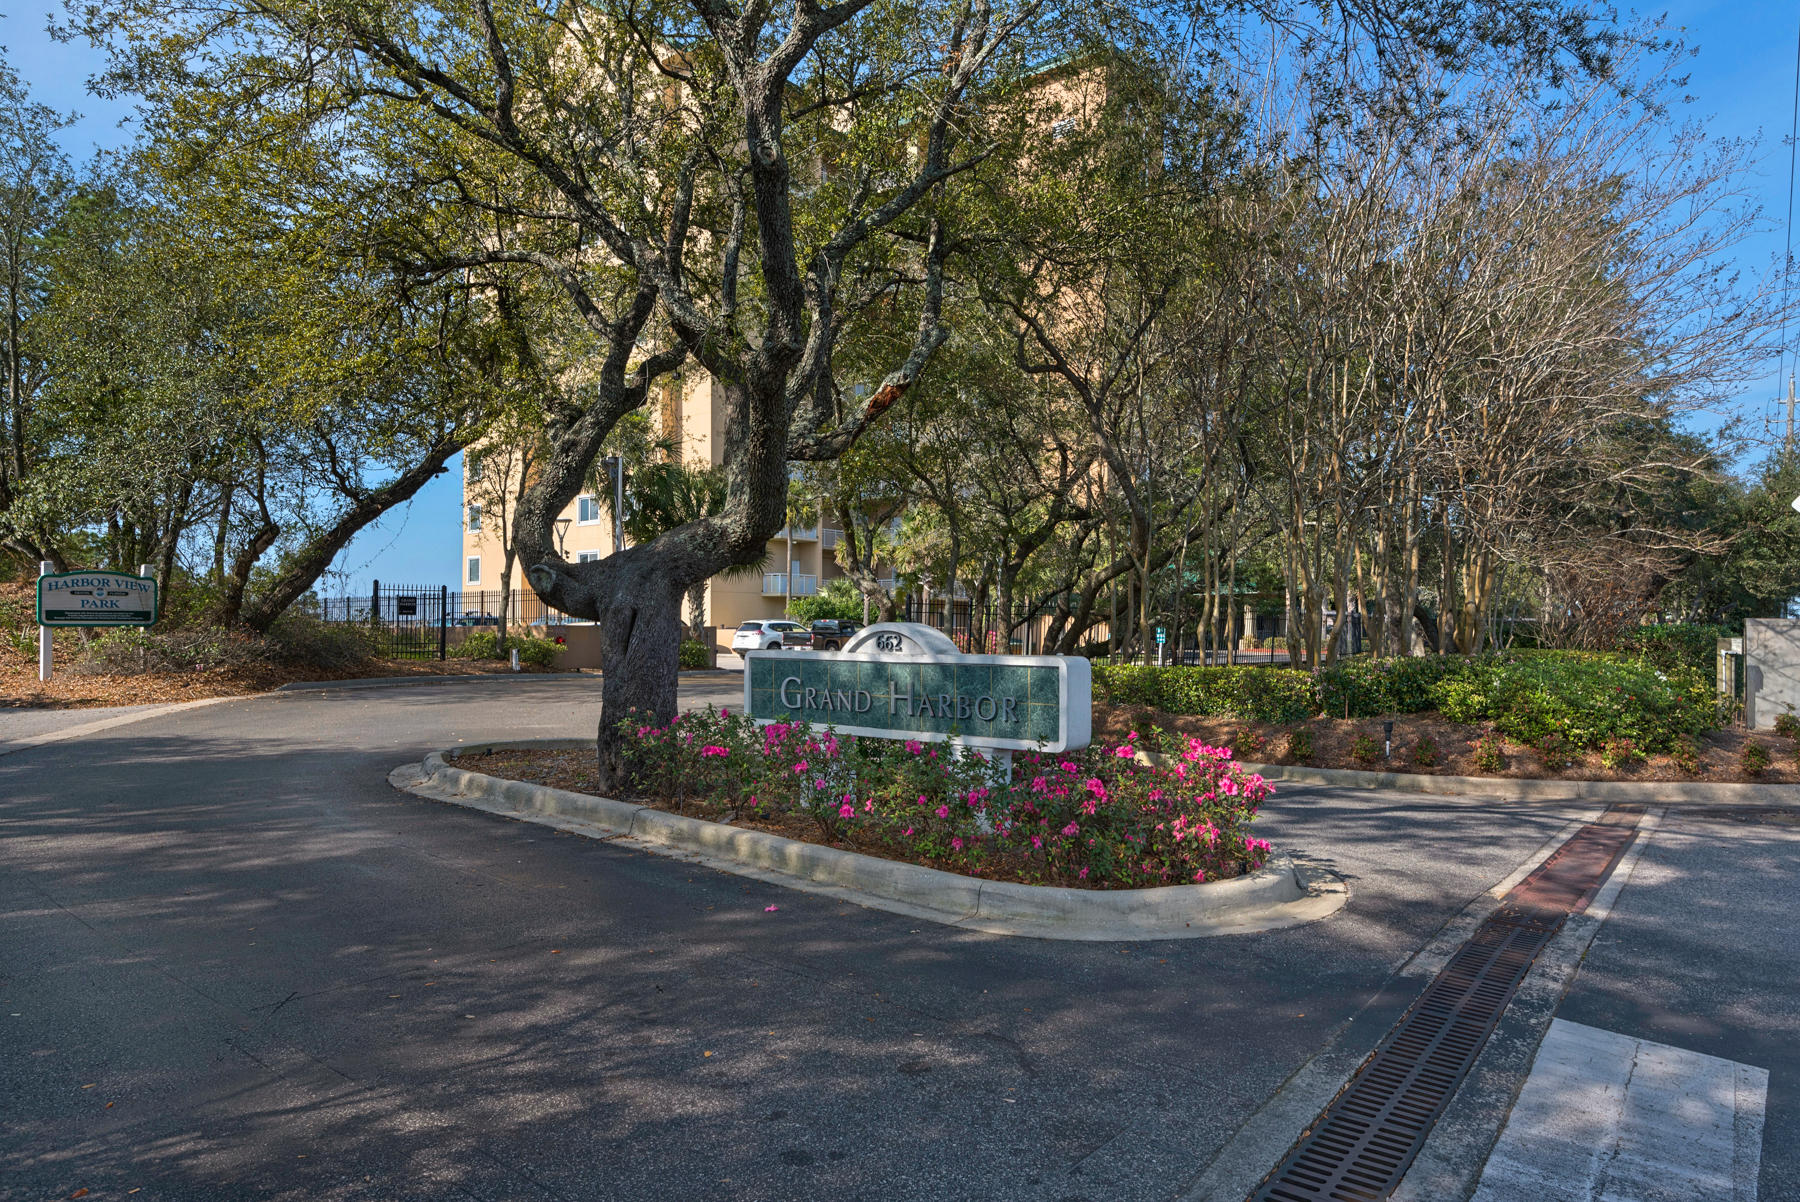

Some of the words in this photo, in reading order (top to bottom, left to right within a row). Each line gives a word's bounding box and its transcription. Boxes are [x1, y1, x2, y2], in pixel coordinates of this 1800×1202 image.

[48, 578, 111, 591] HARBOR
[115, 579, 151, 593] VIEW
[81, 600, 120, 608] PARK
[876, 634, 903, 652] 662
[780, 677, 873, 713] GRAND
[889, 680, 1020, 724] HARBOR
